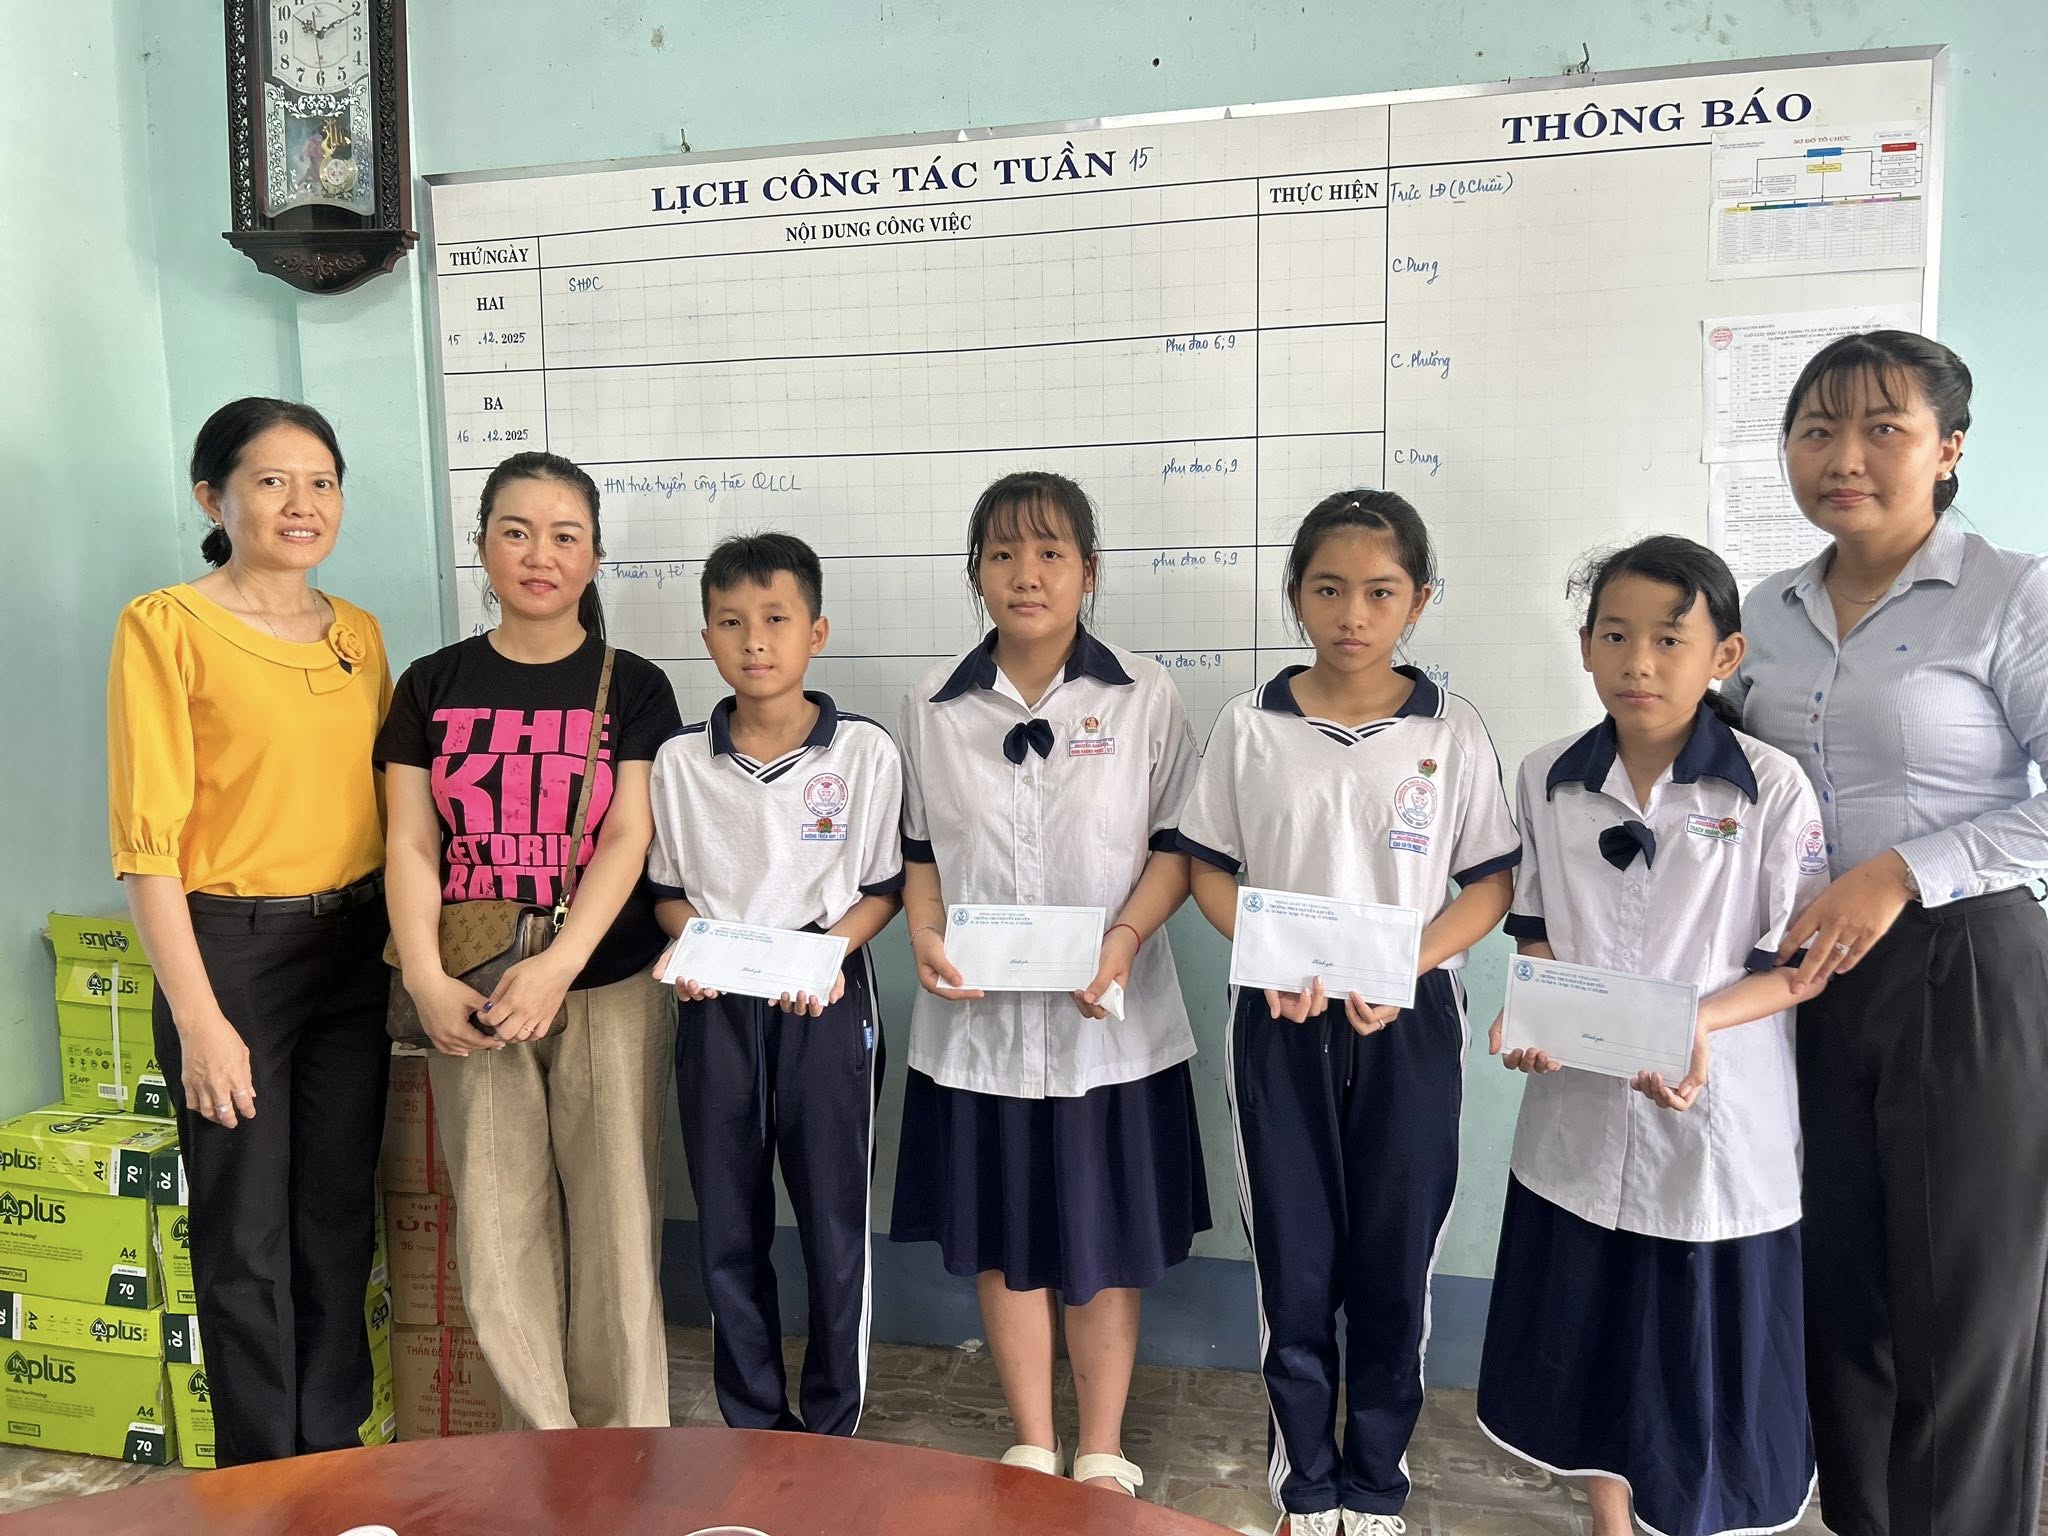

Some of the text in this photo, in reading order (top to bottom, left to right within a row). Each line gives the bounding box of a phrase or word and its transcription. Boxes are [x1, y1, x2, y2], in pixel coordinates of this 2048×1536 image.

[278, 5, 291, 21] 10
[279, 29, 288, 45] 9
[353, 26, 361, 41] 3
[280, 54, 289, 69] 8
[352, 50, 361, 65] 4
[296, 67, 305, 82] 7
[316, 70, 325, 86] 6
[337, 65, 346, 81] 5
[1502, 87, 1813, 146] THÔNG BÁO
[651, 141, 1154, 214] LỊCH CÔNG TÁC TUẦN 15
[1270, 179, 1379, 206] THỰC HIỆN
[785, 212, 972, 246] NỘI DUNG CÔNG VIỆC
[476, 296, 505, 311] HAI
[483, 396, 504, 411] BA
[456, 431, 470, 443] 16
[752, 472, 802, 492] QLCL
[432, 708, 611, 760] THE
[102, 976, 134, 996] pus
[145, 1092, 160, 1105] 70
[126, 1165, 139, 1184] 70
[160, 1171, 172, 1190] 70
[18, 1193, 67, 1226] plus
[119, 1247, 137, 1260] A4
[119, 1283, 135, 1296] 70
[106, 1320, 143, 1343] plus
[171, 1330, 184, 1348] 70
[28, 1354, 77, 1385] plus
[136, 1405, 155, 1418] A4
[136, 1439, 153, 1453] 70
